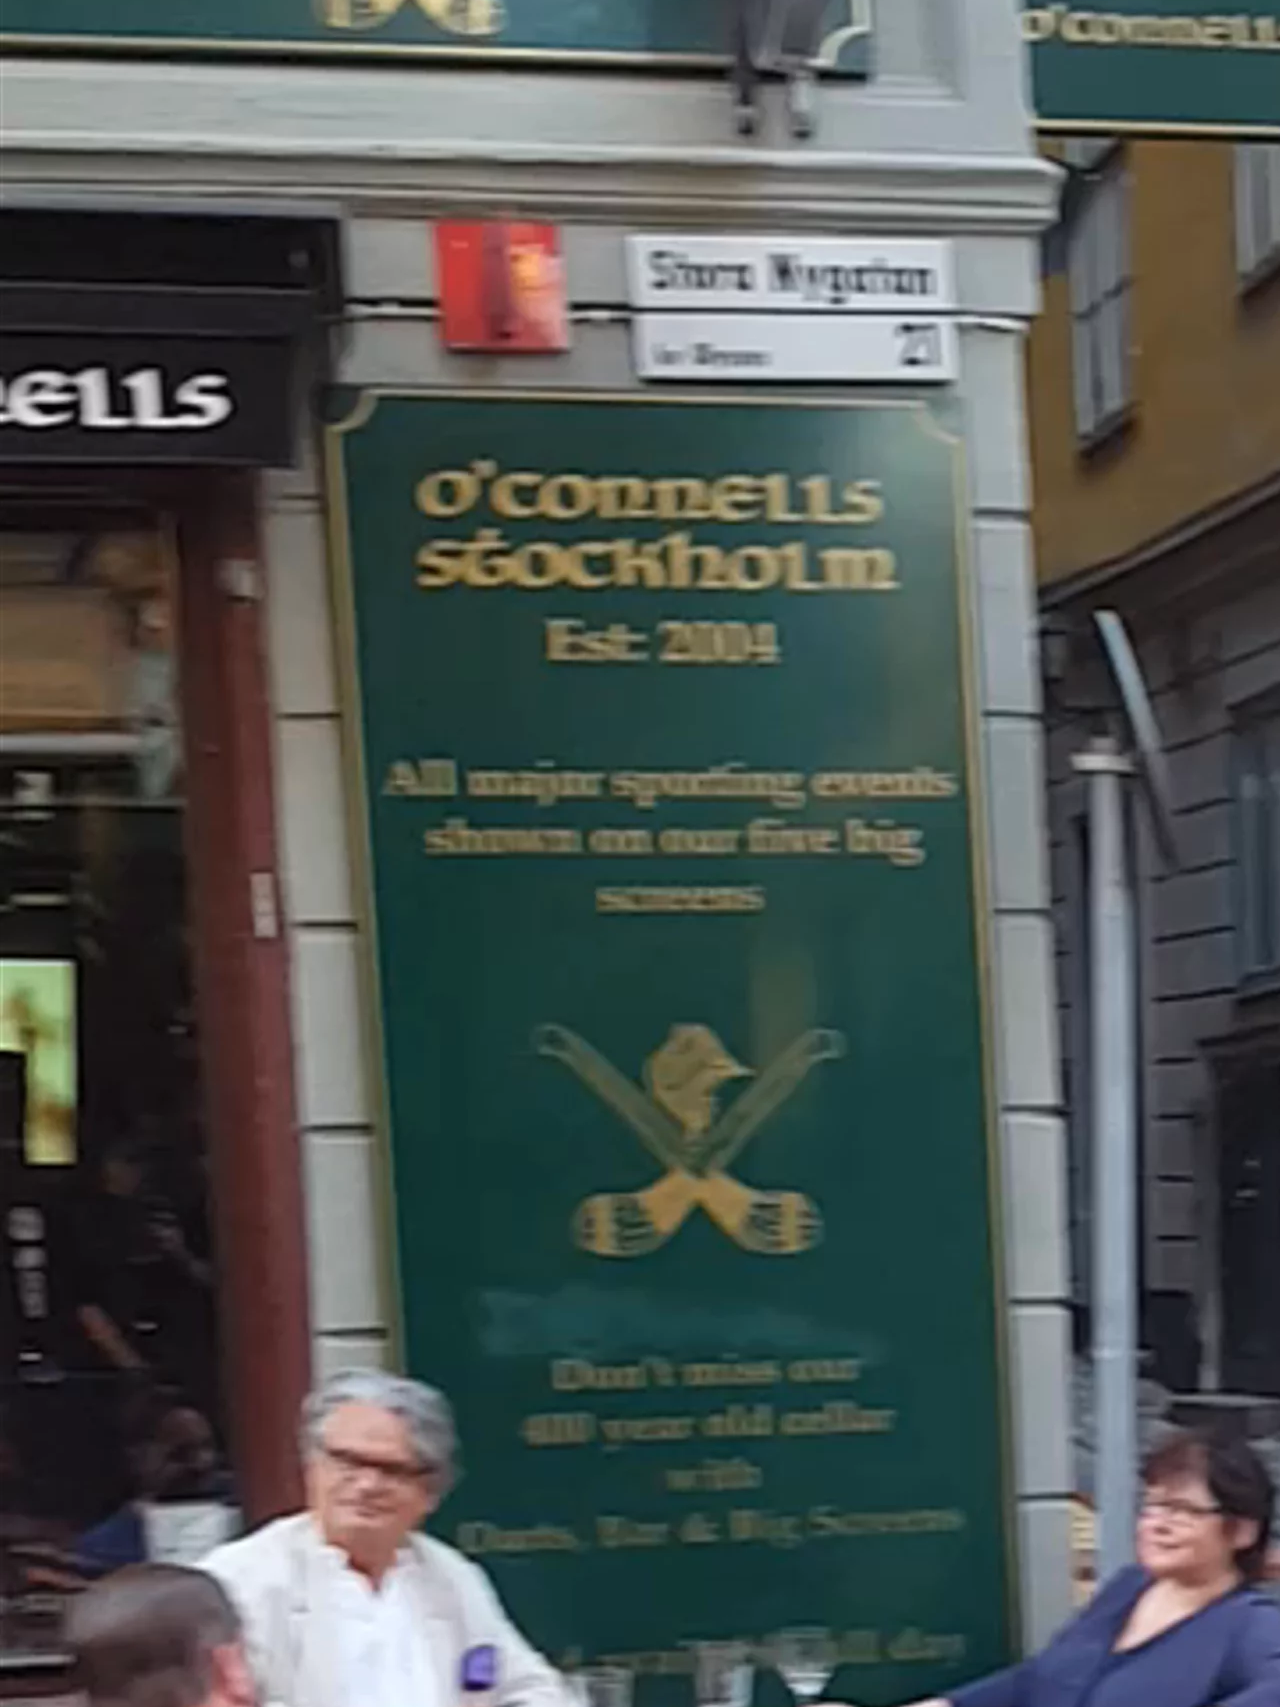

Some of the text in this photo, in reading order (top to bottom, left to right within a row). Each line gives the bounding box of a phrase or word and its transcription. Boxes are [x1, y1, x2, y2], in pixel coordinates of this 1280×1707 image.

[647, 249, 939, 306] Stora Nygatan
[845, 817, 927, 867] big
